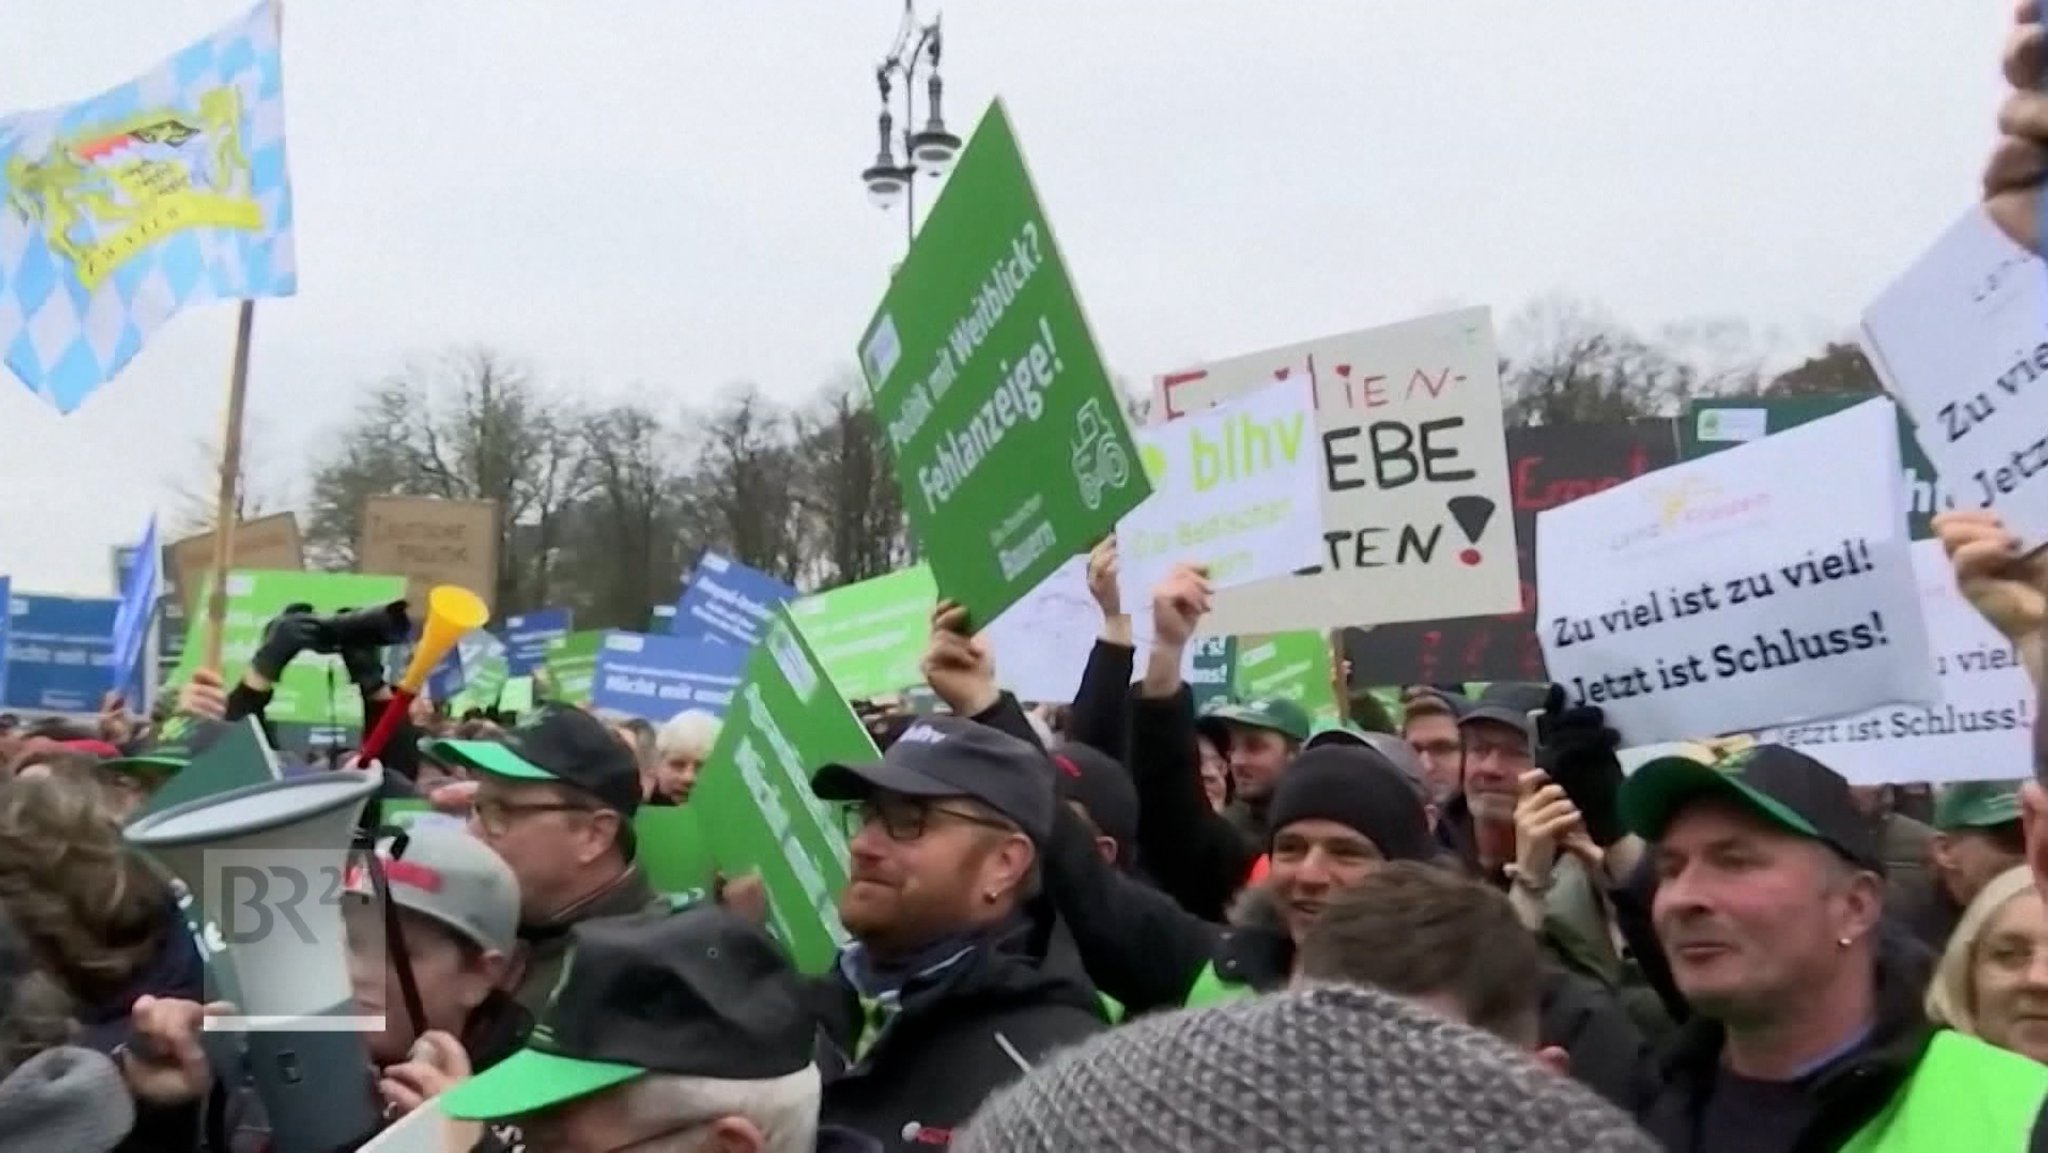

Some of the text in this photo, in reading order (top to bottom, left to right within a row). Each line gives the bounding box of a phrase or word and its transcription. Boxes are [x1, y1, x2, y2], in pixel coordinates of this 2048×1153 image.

[948, 220, 1043, 367] Weitblick?
[917, 314, 1065, 515] Fehlanzeige!
[1187, 411, 1305, 493] blhv
[1322, 416, 1476, 491] EBE
[1938, 393, 1995, 443] Zu
[1553, 538, 1875, 648] Zu viel ist zu viel!
[1572, 666, 1653, 708] Jetzt
[1656, 655, 1708, 690] ist
[1712, 610, 1890, 678] Schluss!
[1890, 699, 2033, 739] Schluss!
